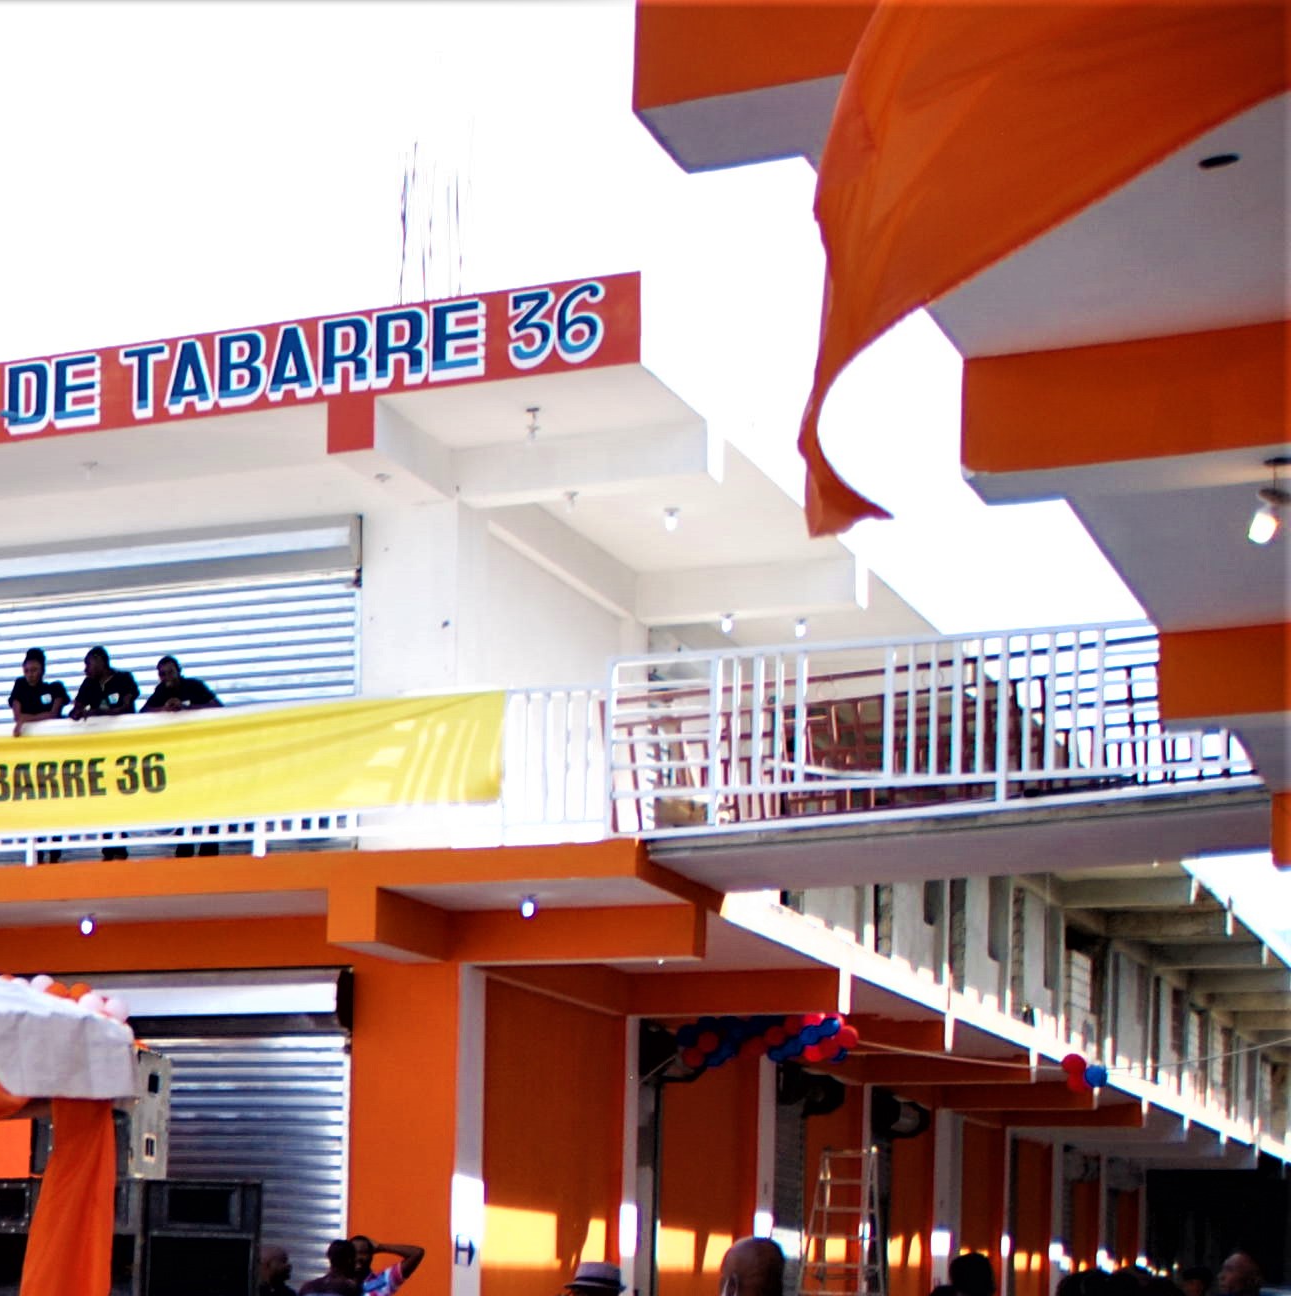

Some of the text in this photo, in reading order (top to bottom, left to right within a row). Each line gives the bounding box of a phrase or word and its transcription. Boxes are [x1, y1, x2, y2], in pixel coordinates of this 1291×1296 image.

[1, 354, 103, 436] DE
[119, 300, 485, 419] TABARRE
[507, 280, 607, 368] 36
[116, 752, 168, 795] 36
